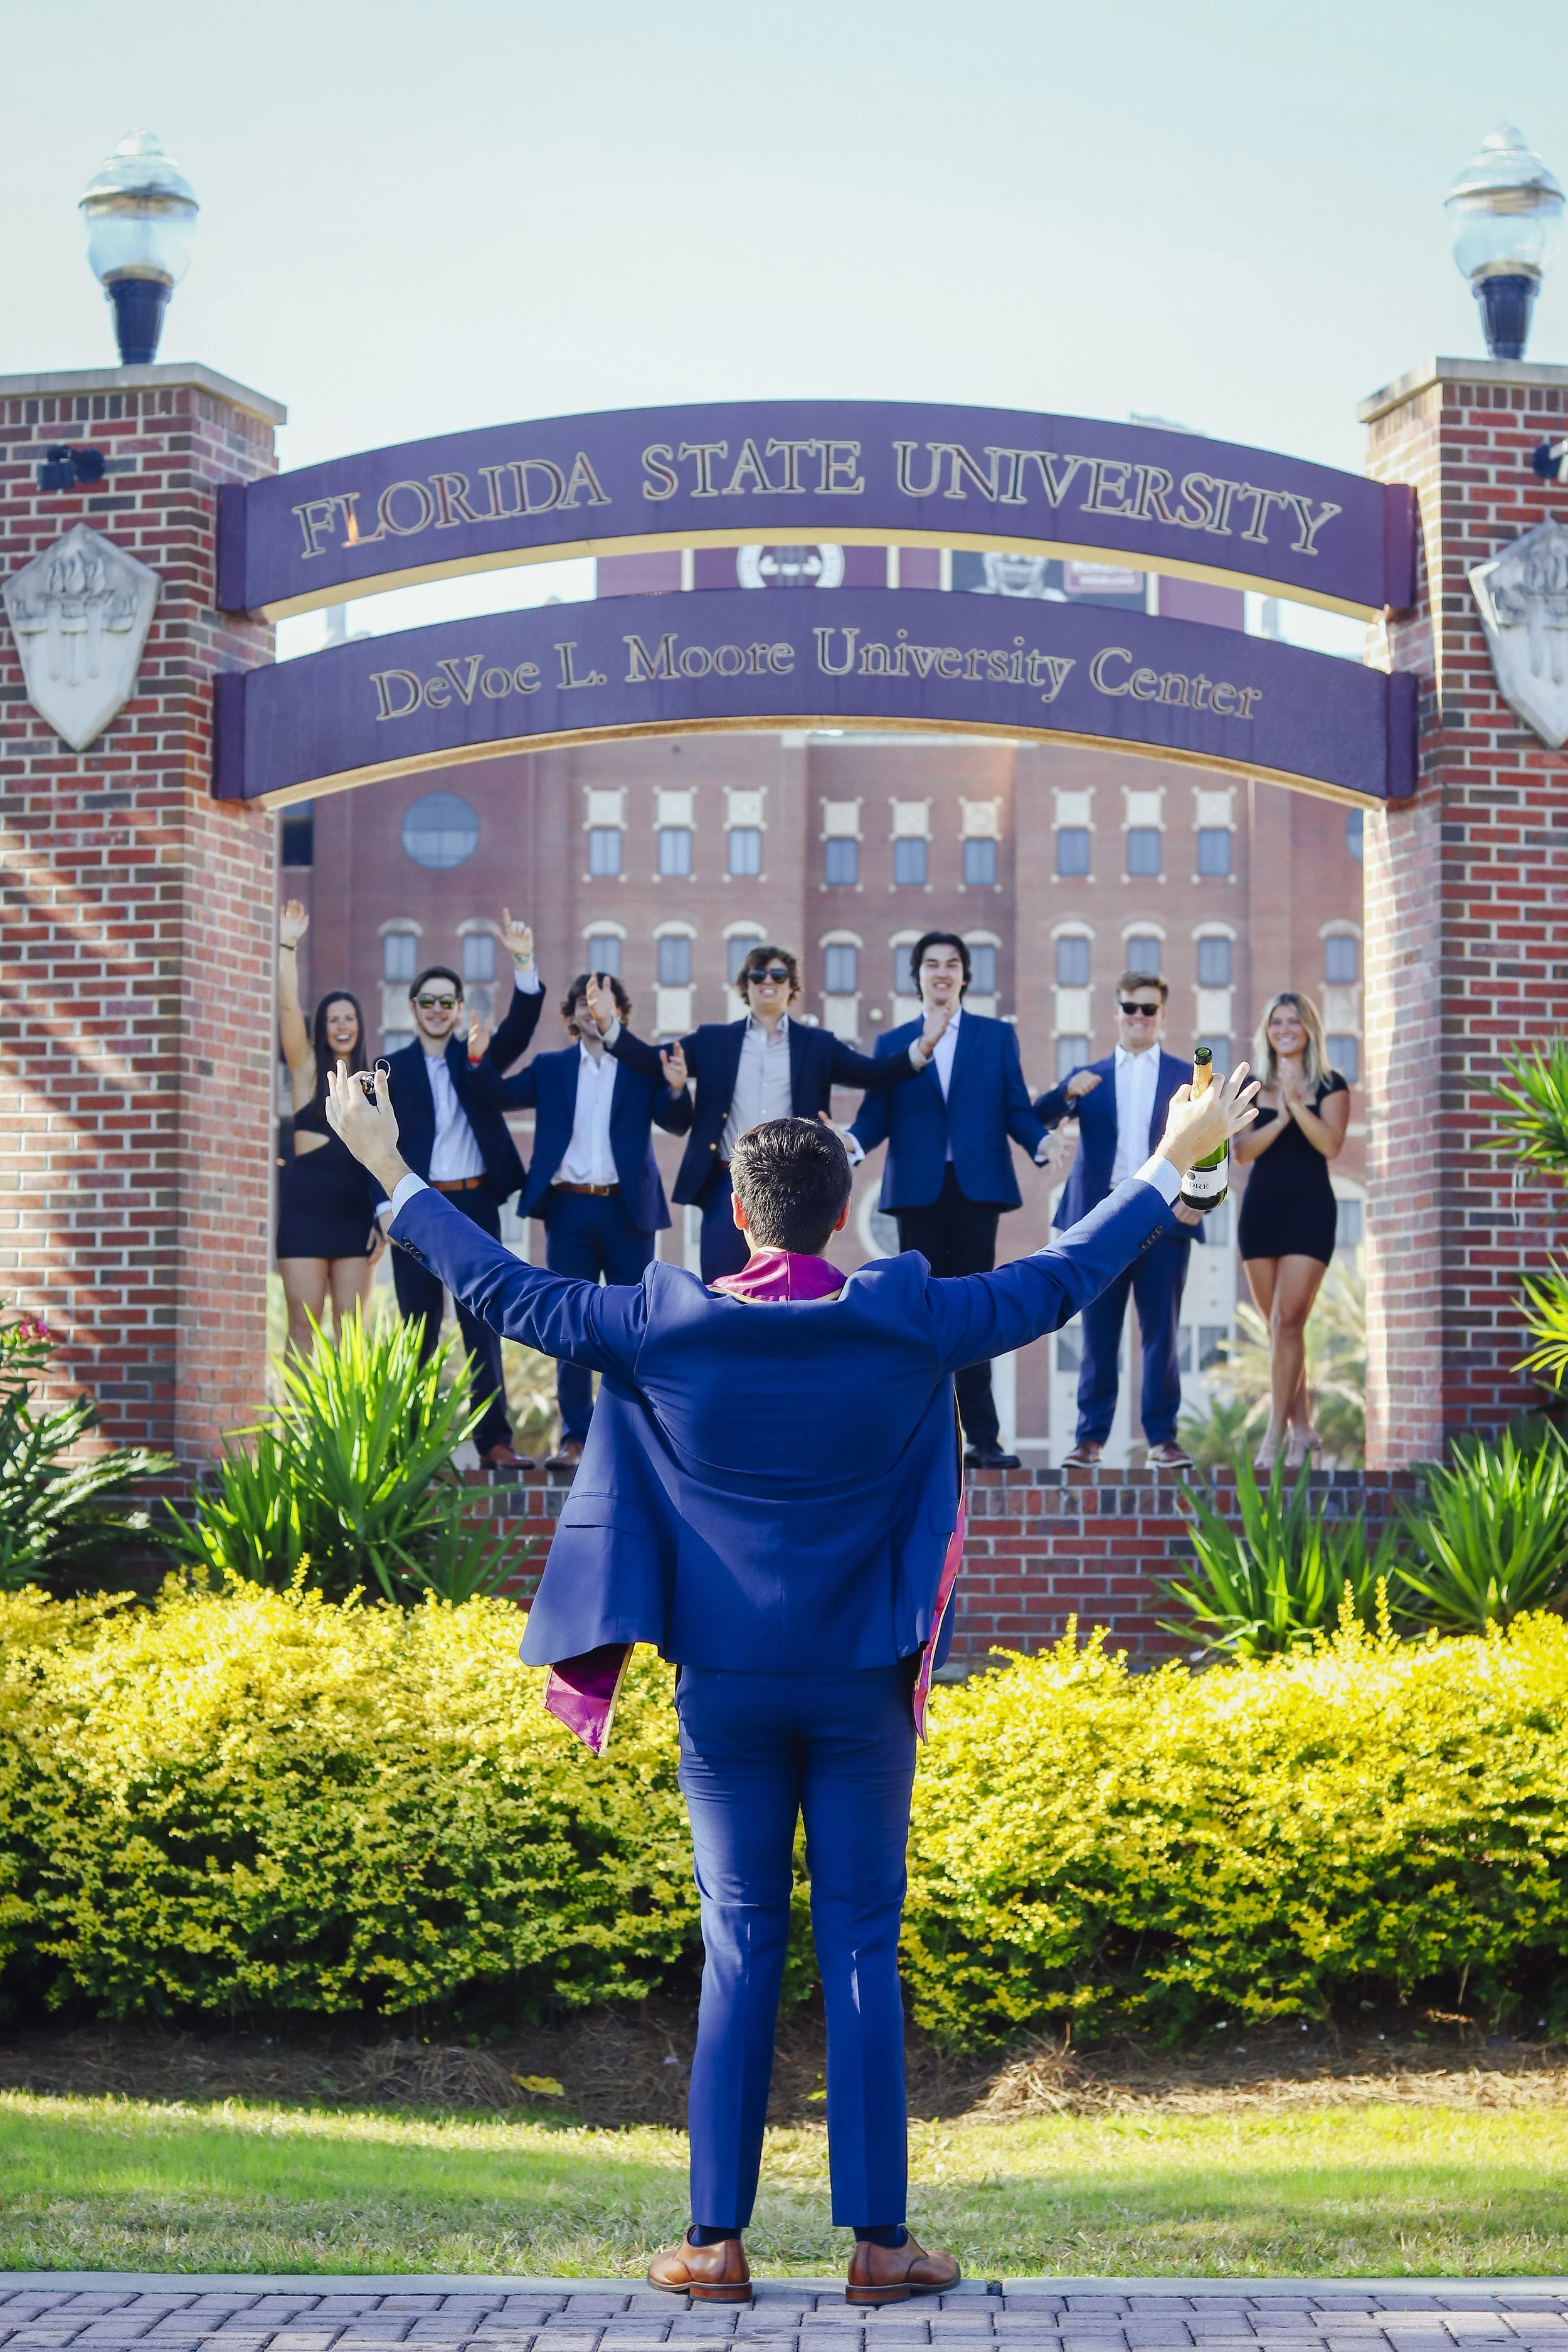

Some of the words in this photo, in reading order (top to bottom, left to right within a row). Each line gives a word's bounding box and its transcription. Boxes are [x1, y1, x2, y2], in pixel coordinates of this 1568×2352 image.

[292, 452, 612, 559] FLORIDA
[642, 438, 864, 501] STATE
[893, 442, 1342, 556] UNIVERSITY
[369, 654, 541, 721] DeVoe
[554, 642, 607, 689] L.
[623, 633, 795, 683] Moore
[813, 628, 1076, 703] University
[1090, 647, 1263, 720] Center
